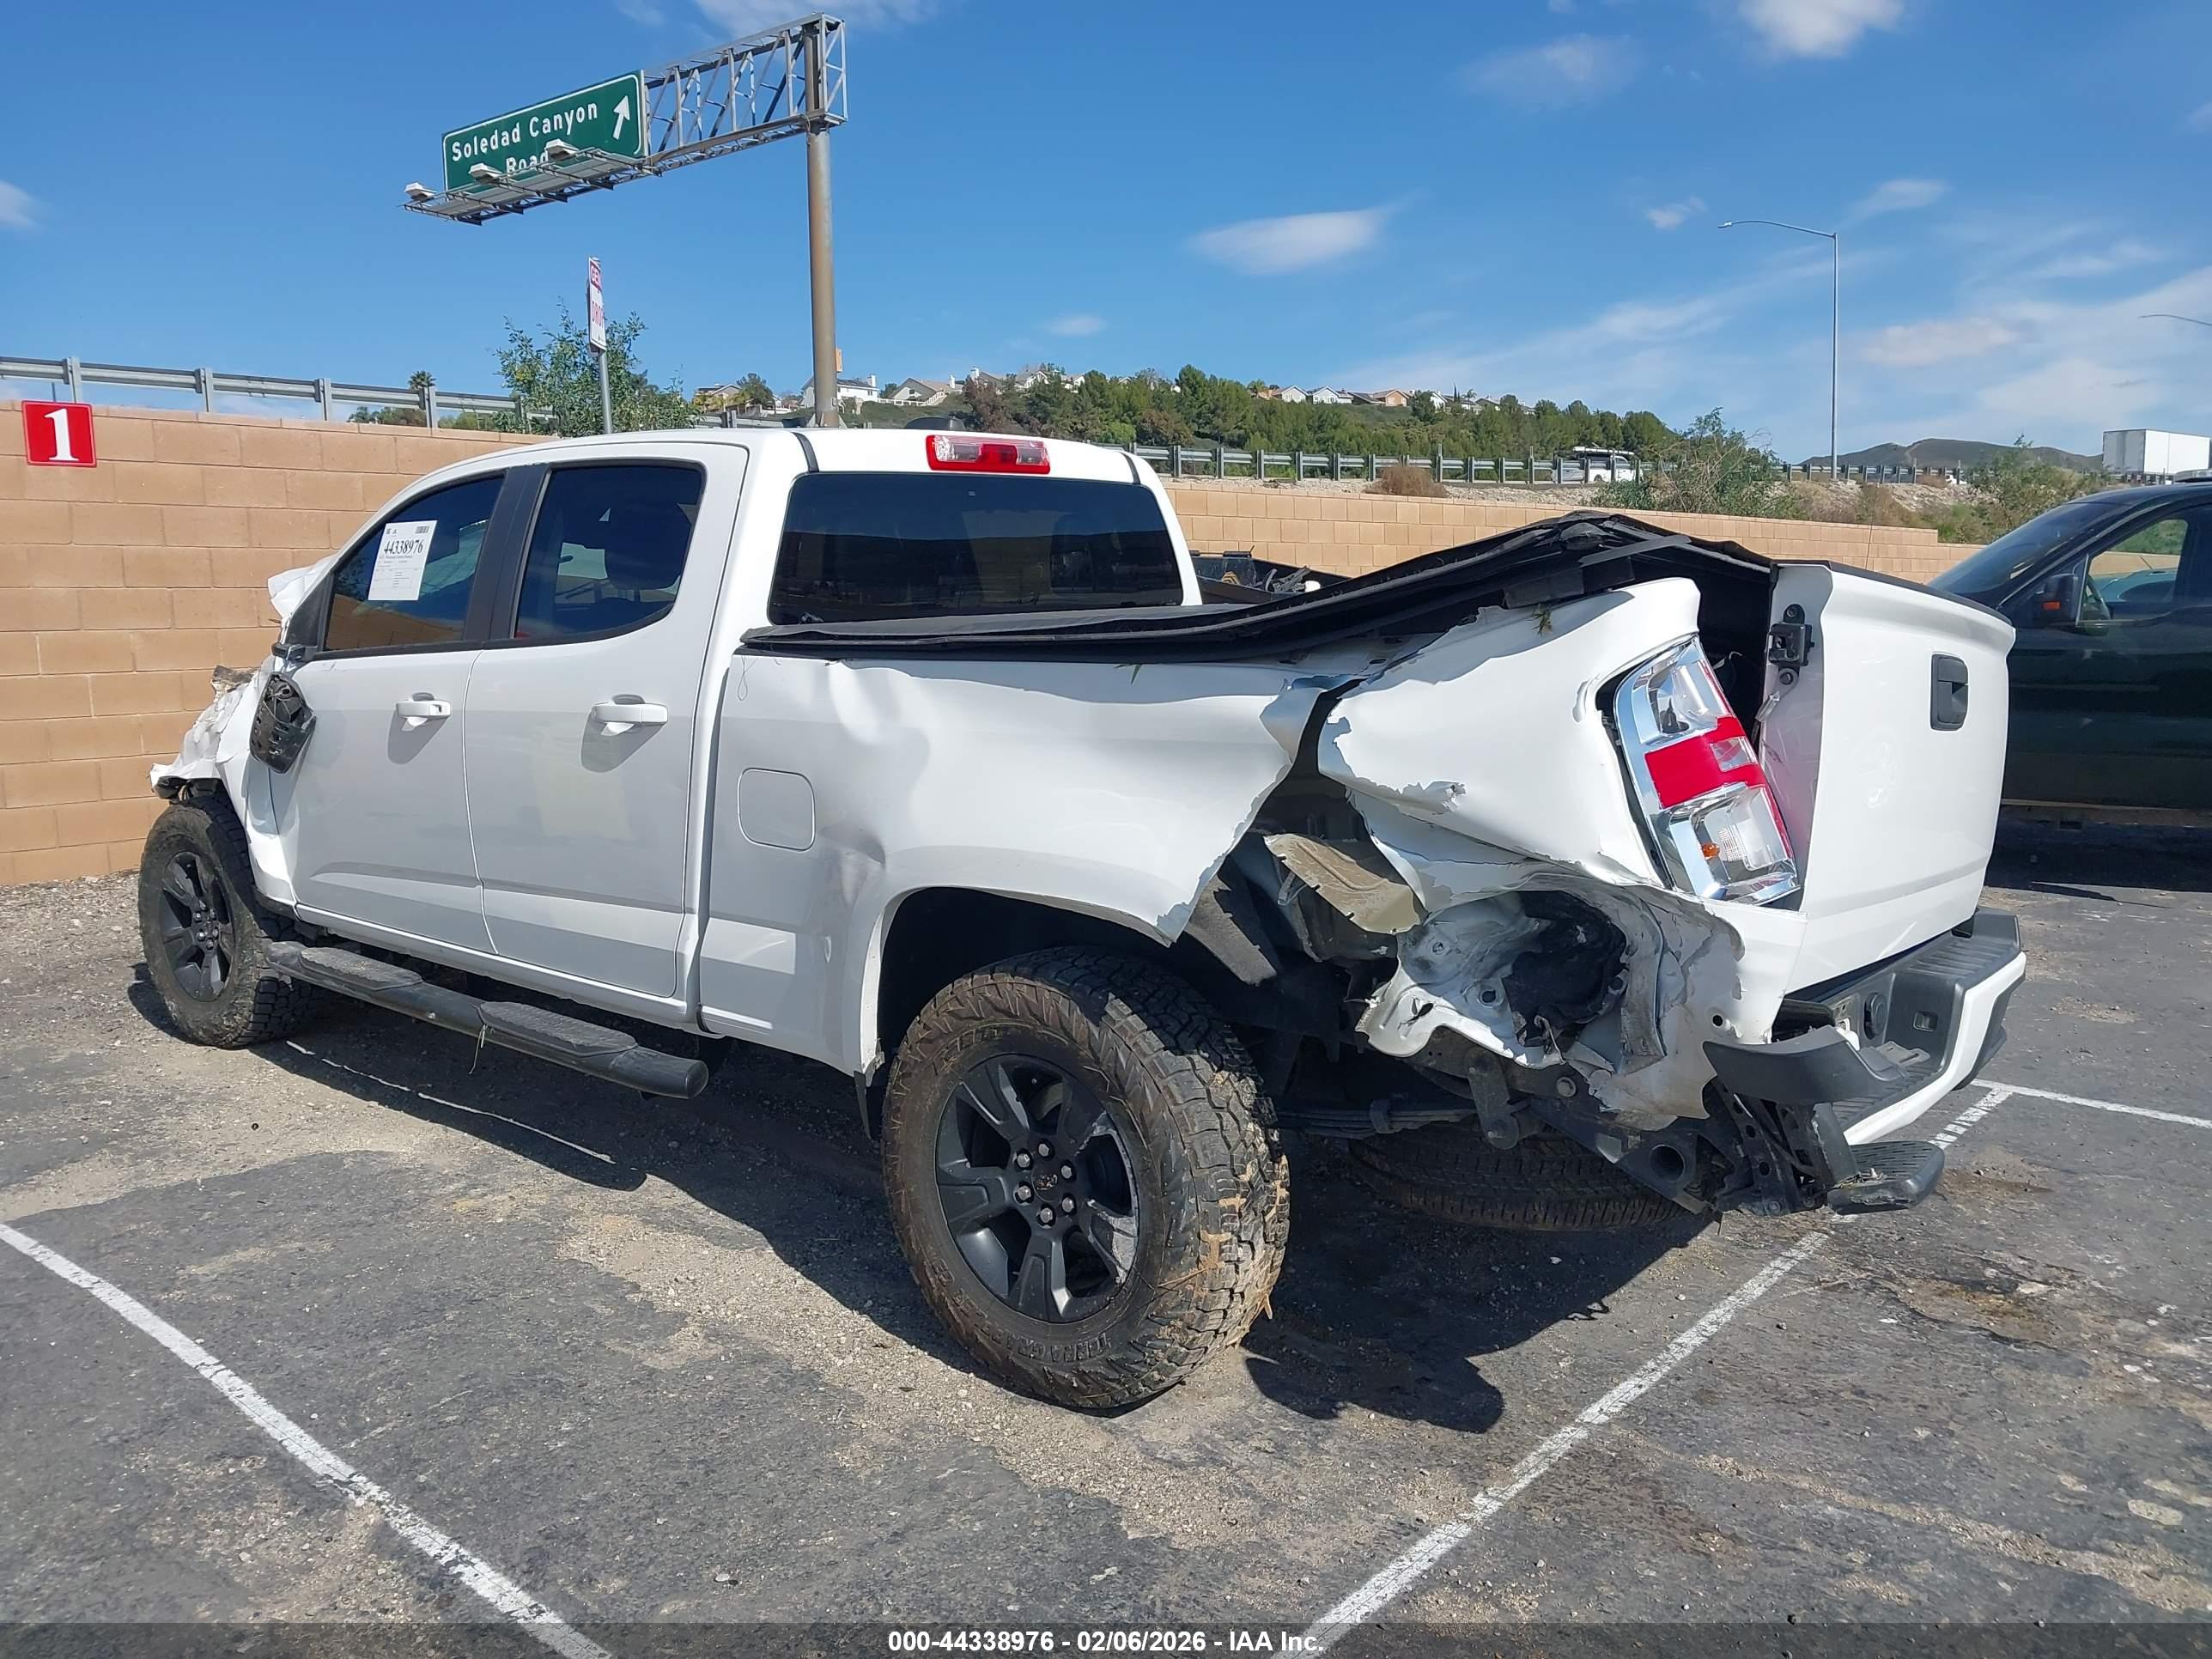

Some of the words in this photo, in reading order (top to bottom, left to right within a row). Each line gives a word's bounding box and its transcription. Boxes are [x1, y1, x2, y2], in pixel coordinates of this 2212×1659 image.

[452, 123, 520, 161] Soledad
[529, 102, 598, 137] Canyon
[506, 148, 549, 173] Road
[44, 408, 79, 460] 1
[384, 538, 425, 554] 44338976
